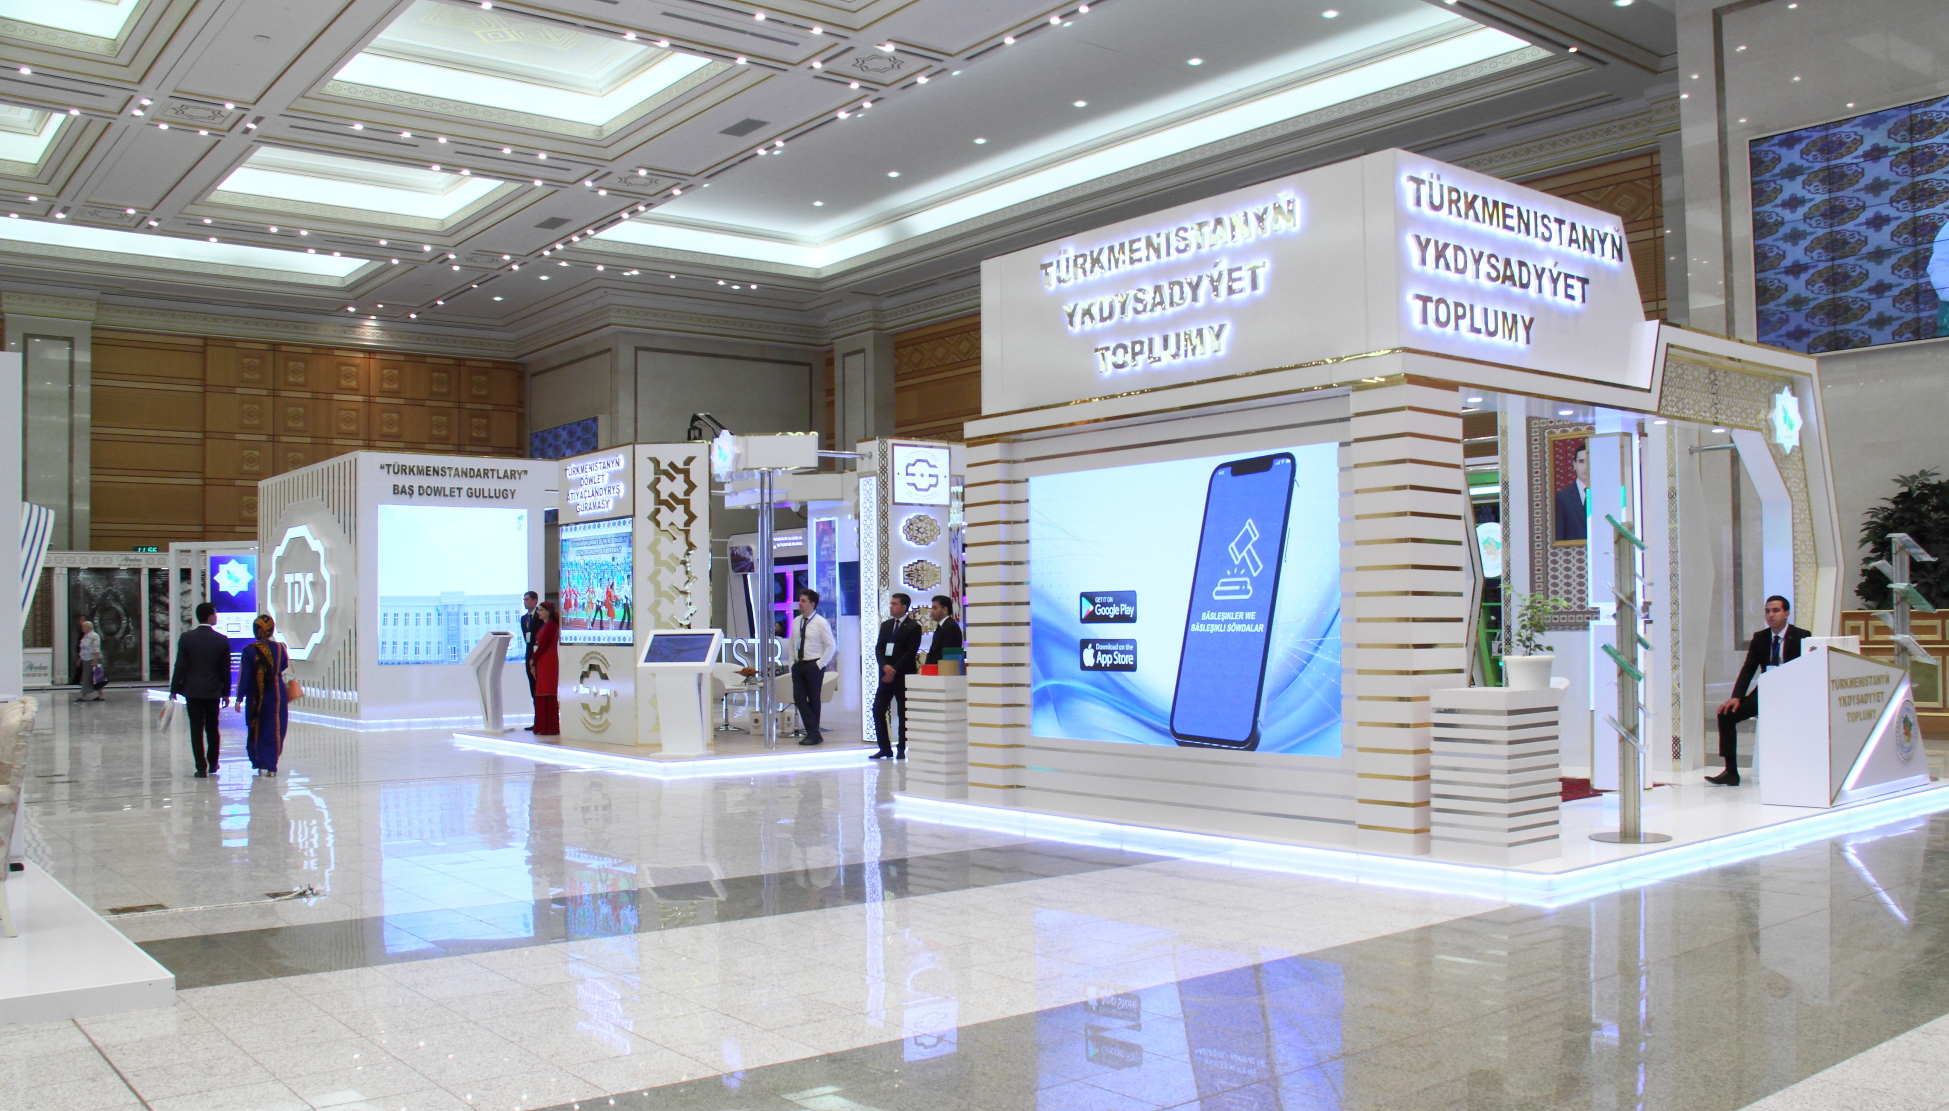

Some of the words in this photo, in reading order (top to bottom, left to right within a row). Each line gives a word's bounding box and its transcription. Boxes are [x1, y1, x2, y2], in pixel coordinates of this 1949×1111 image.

[1407, 173, 1624, 262] TÜRKMENISTANYŇ
[1040, 192, 1297, 289] TÜRKMENISTANYŇ
[1413, 234, 1589, 304] YKDYSADYÝET
[1063, 259, 1267, 330] YKDYSADYÝET
[1412, 293, 1535, 345] TOPLUMY
[1094, 323, 1227, 374] TOPLUMY
[392, 484, 415, 498] BAŞ
[418, 485, 463, 498] DOWLET
[466, 487, 517, 499] GULLUGY
[284, 572, 315, 614] TDS
[1094, 603, 1120, 618] Google
[1120, 603, 1135, 618] Play
[1245, 611, 1257, 620] WE
[1095, 643, 1118, 651] Download
[1126, 643, 1134, 651] the
[1096, 650, 1113, 667] App
[1113, 650, 1134, 665] Store
[1846, 708, 1877, 723] TOPLUMY
